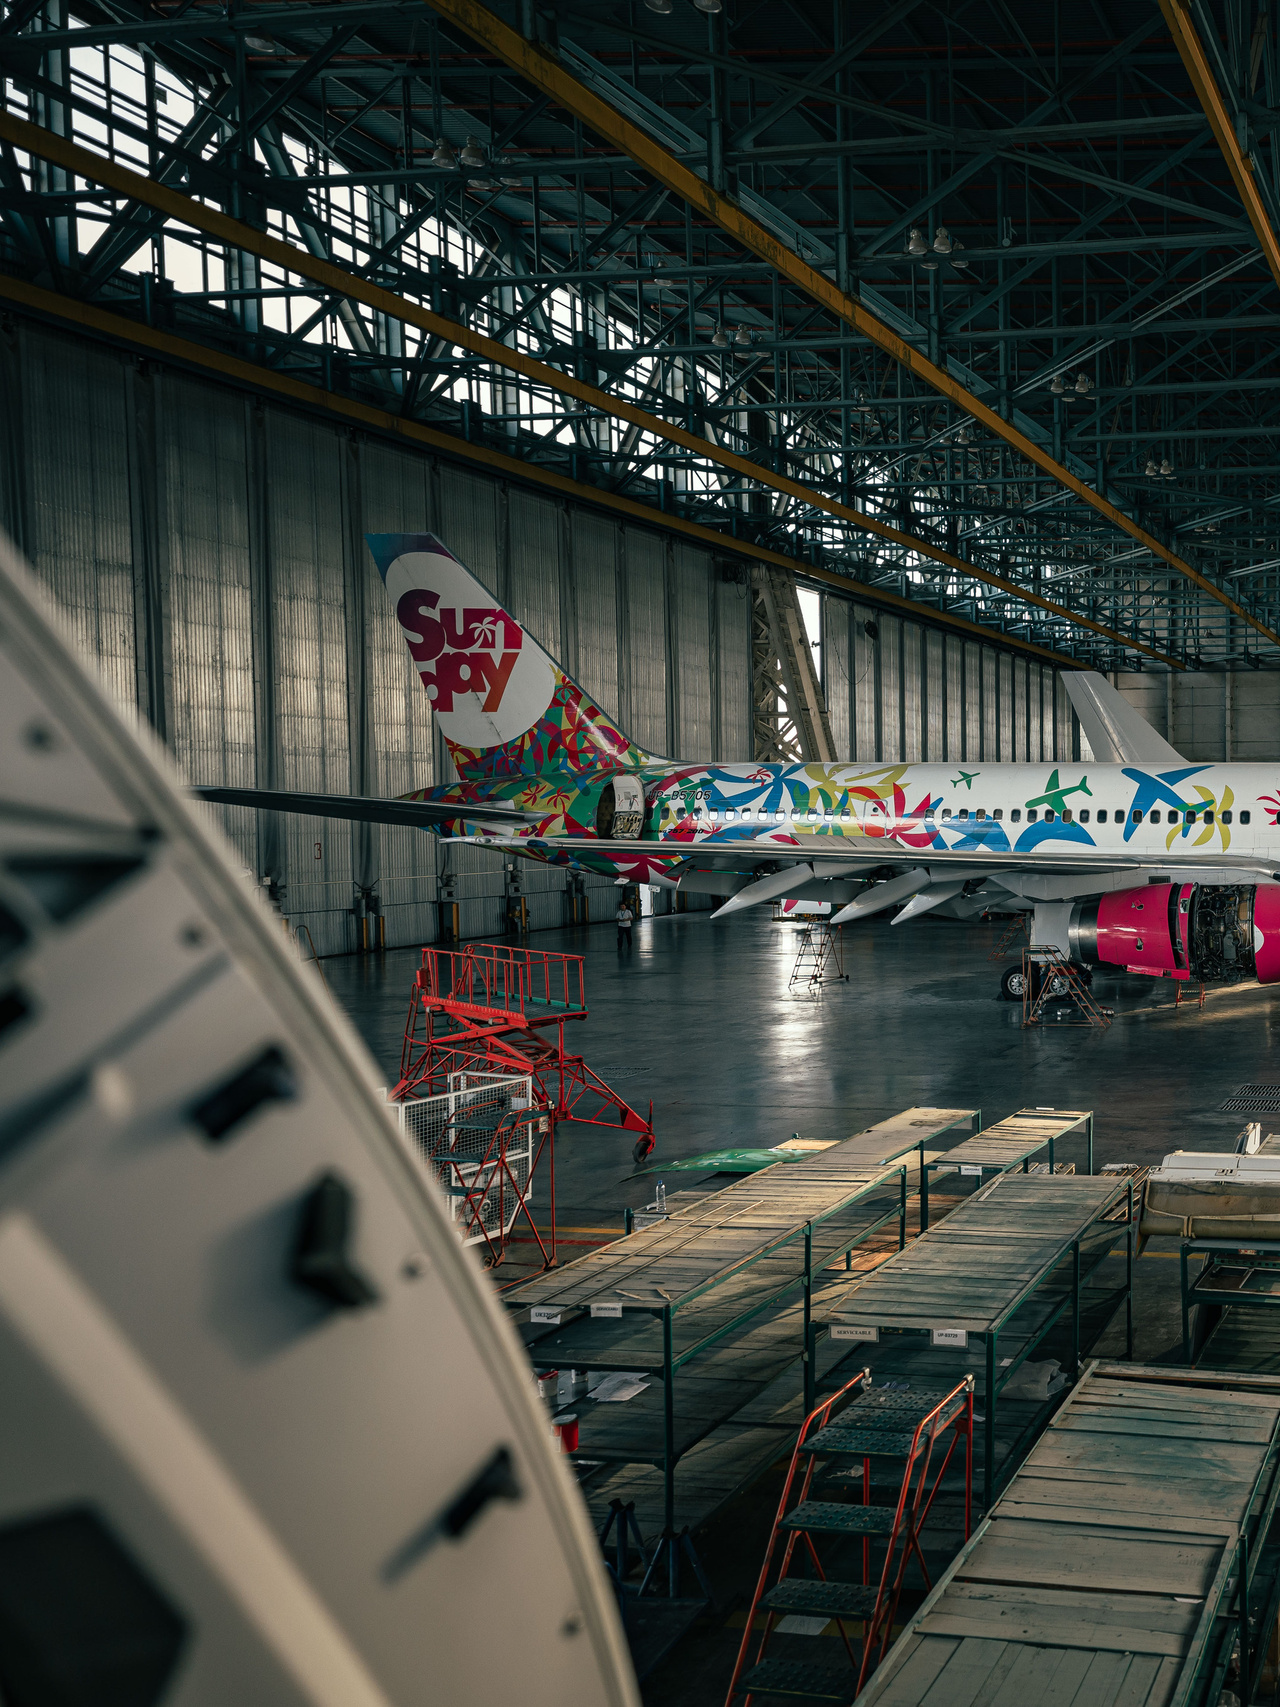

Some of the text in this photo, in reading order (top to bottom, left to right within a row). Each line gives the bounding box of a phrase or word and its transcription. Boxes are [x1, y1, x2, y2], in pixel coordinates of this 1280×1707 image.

[397, 588, 523, 662] Sun
[648, 790, 712, 801] UP-B5705
[313, 842, 322, 860] 3
